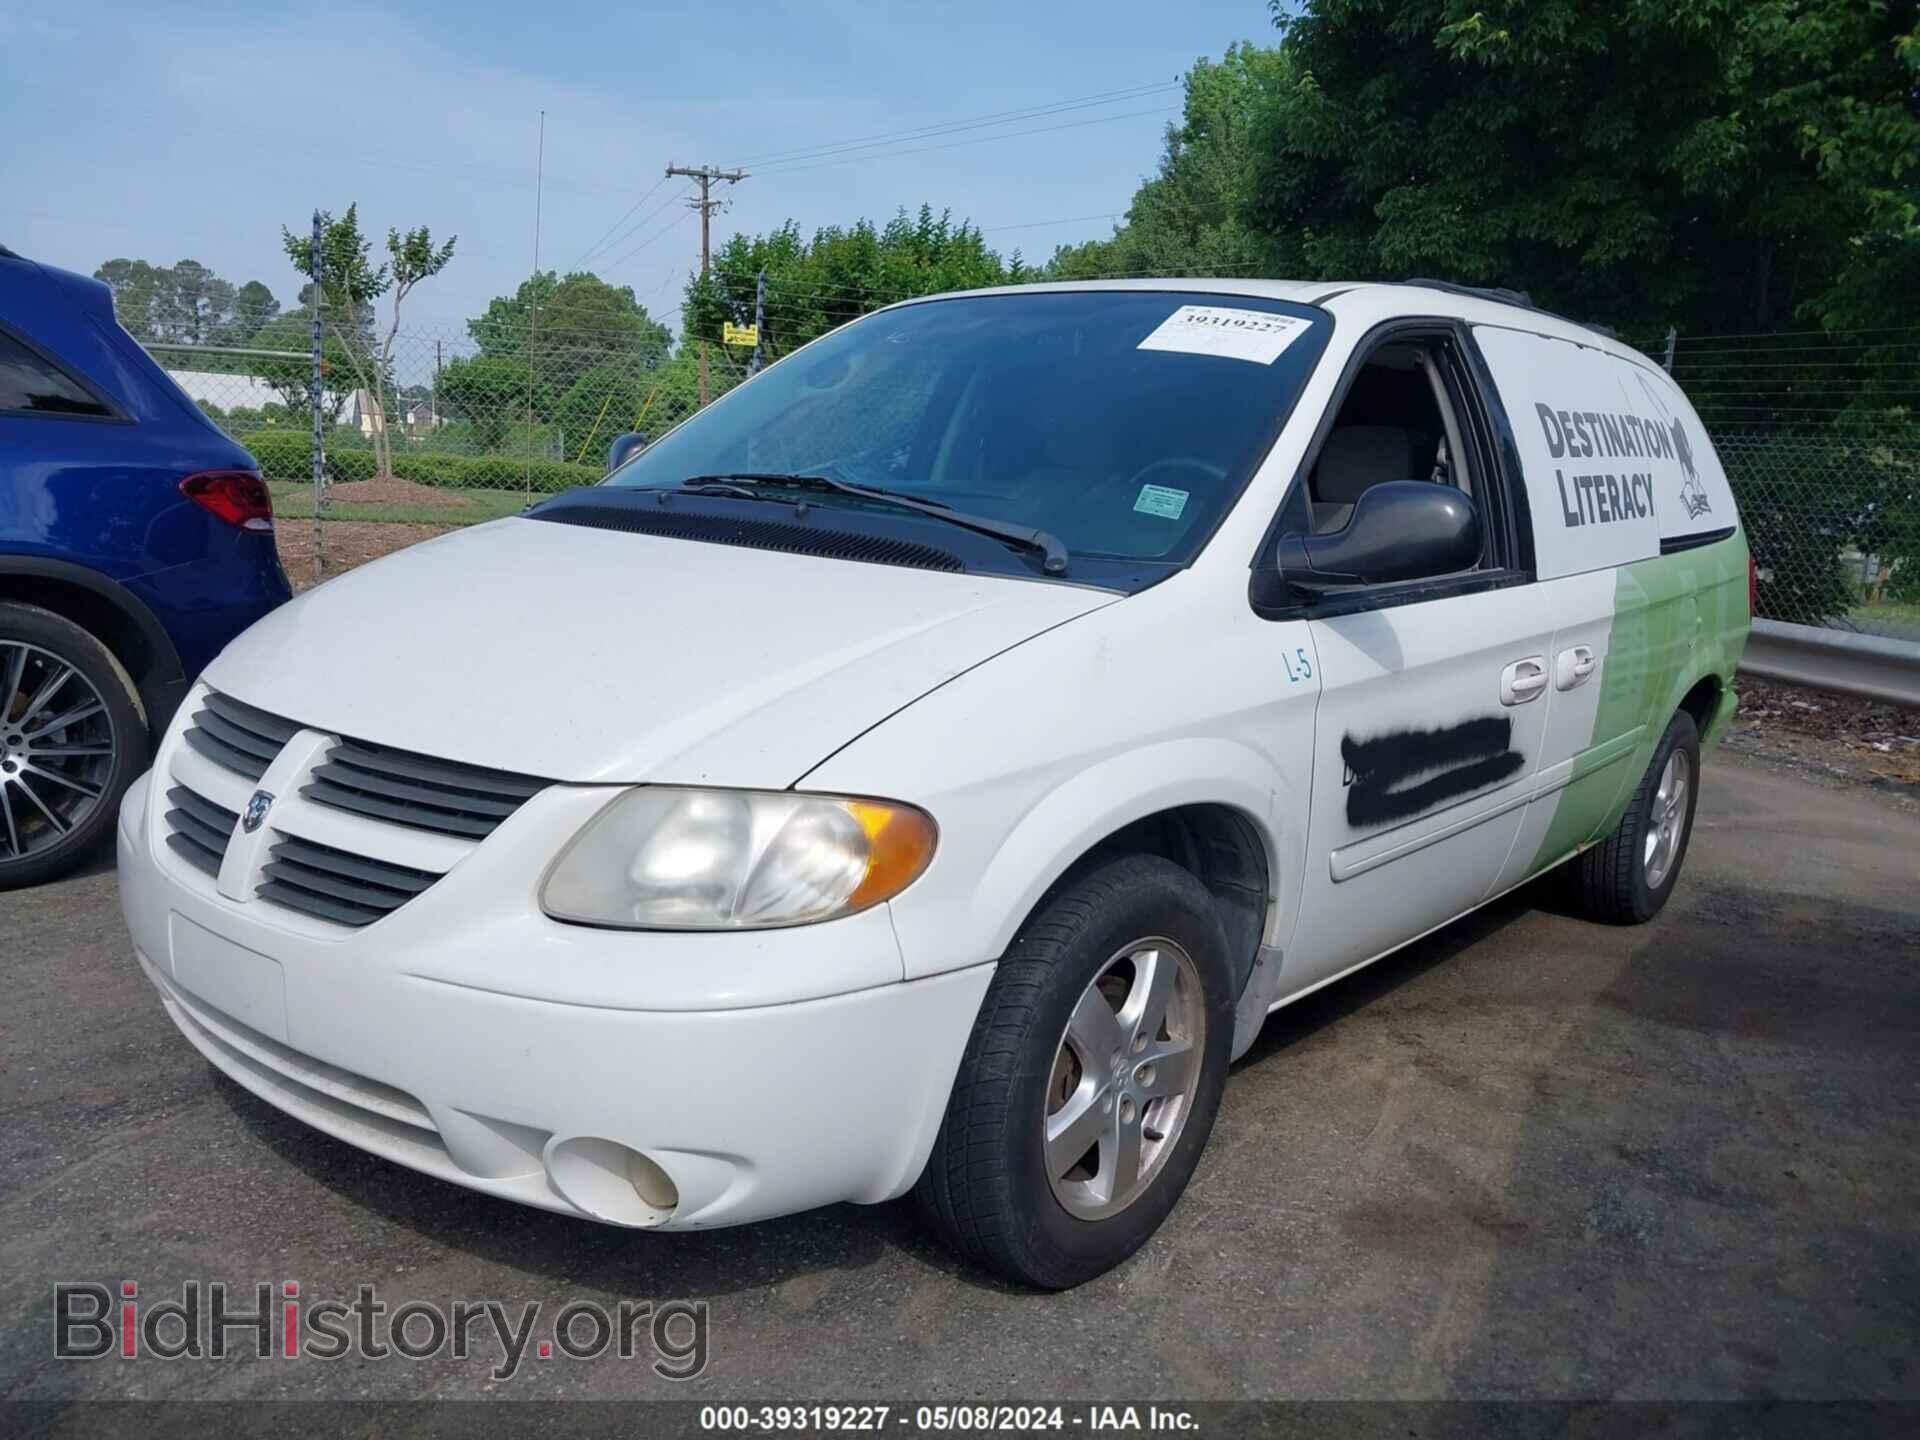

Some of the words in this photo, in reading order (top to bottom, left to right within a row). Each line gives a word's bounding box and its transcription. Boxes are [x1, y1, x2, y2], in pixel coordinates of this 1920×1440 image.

[1186, 314, 1287, 334] 39319227
[1535, 402, 1675, 459] DESTINATION
[1556, 469, 1654, 527] LITERACY
[1281, 648, 1312, 682] L-5
